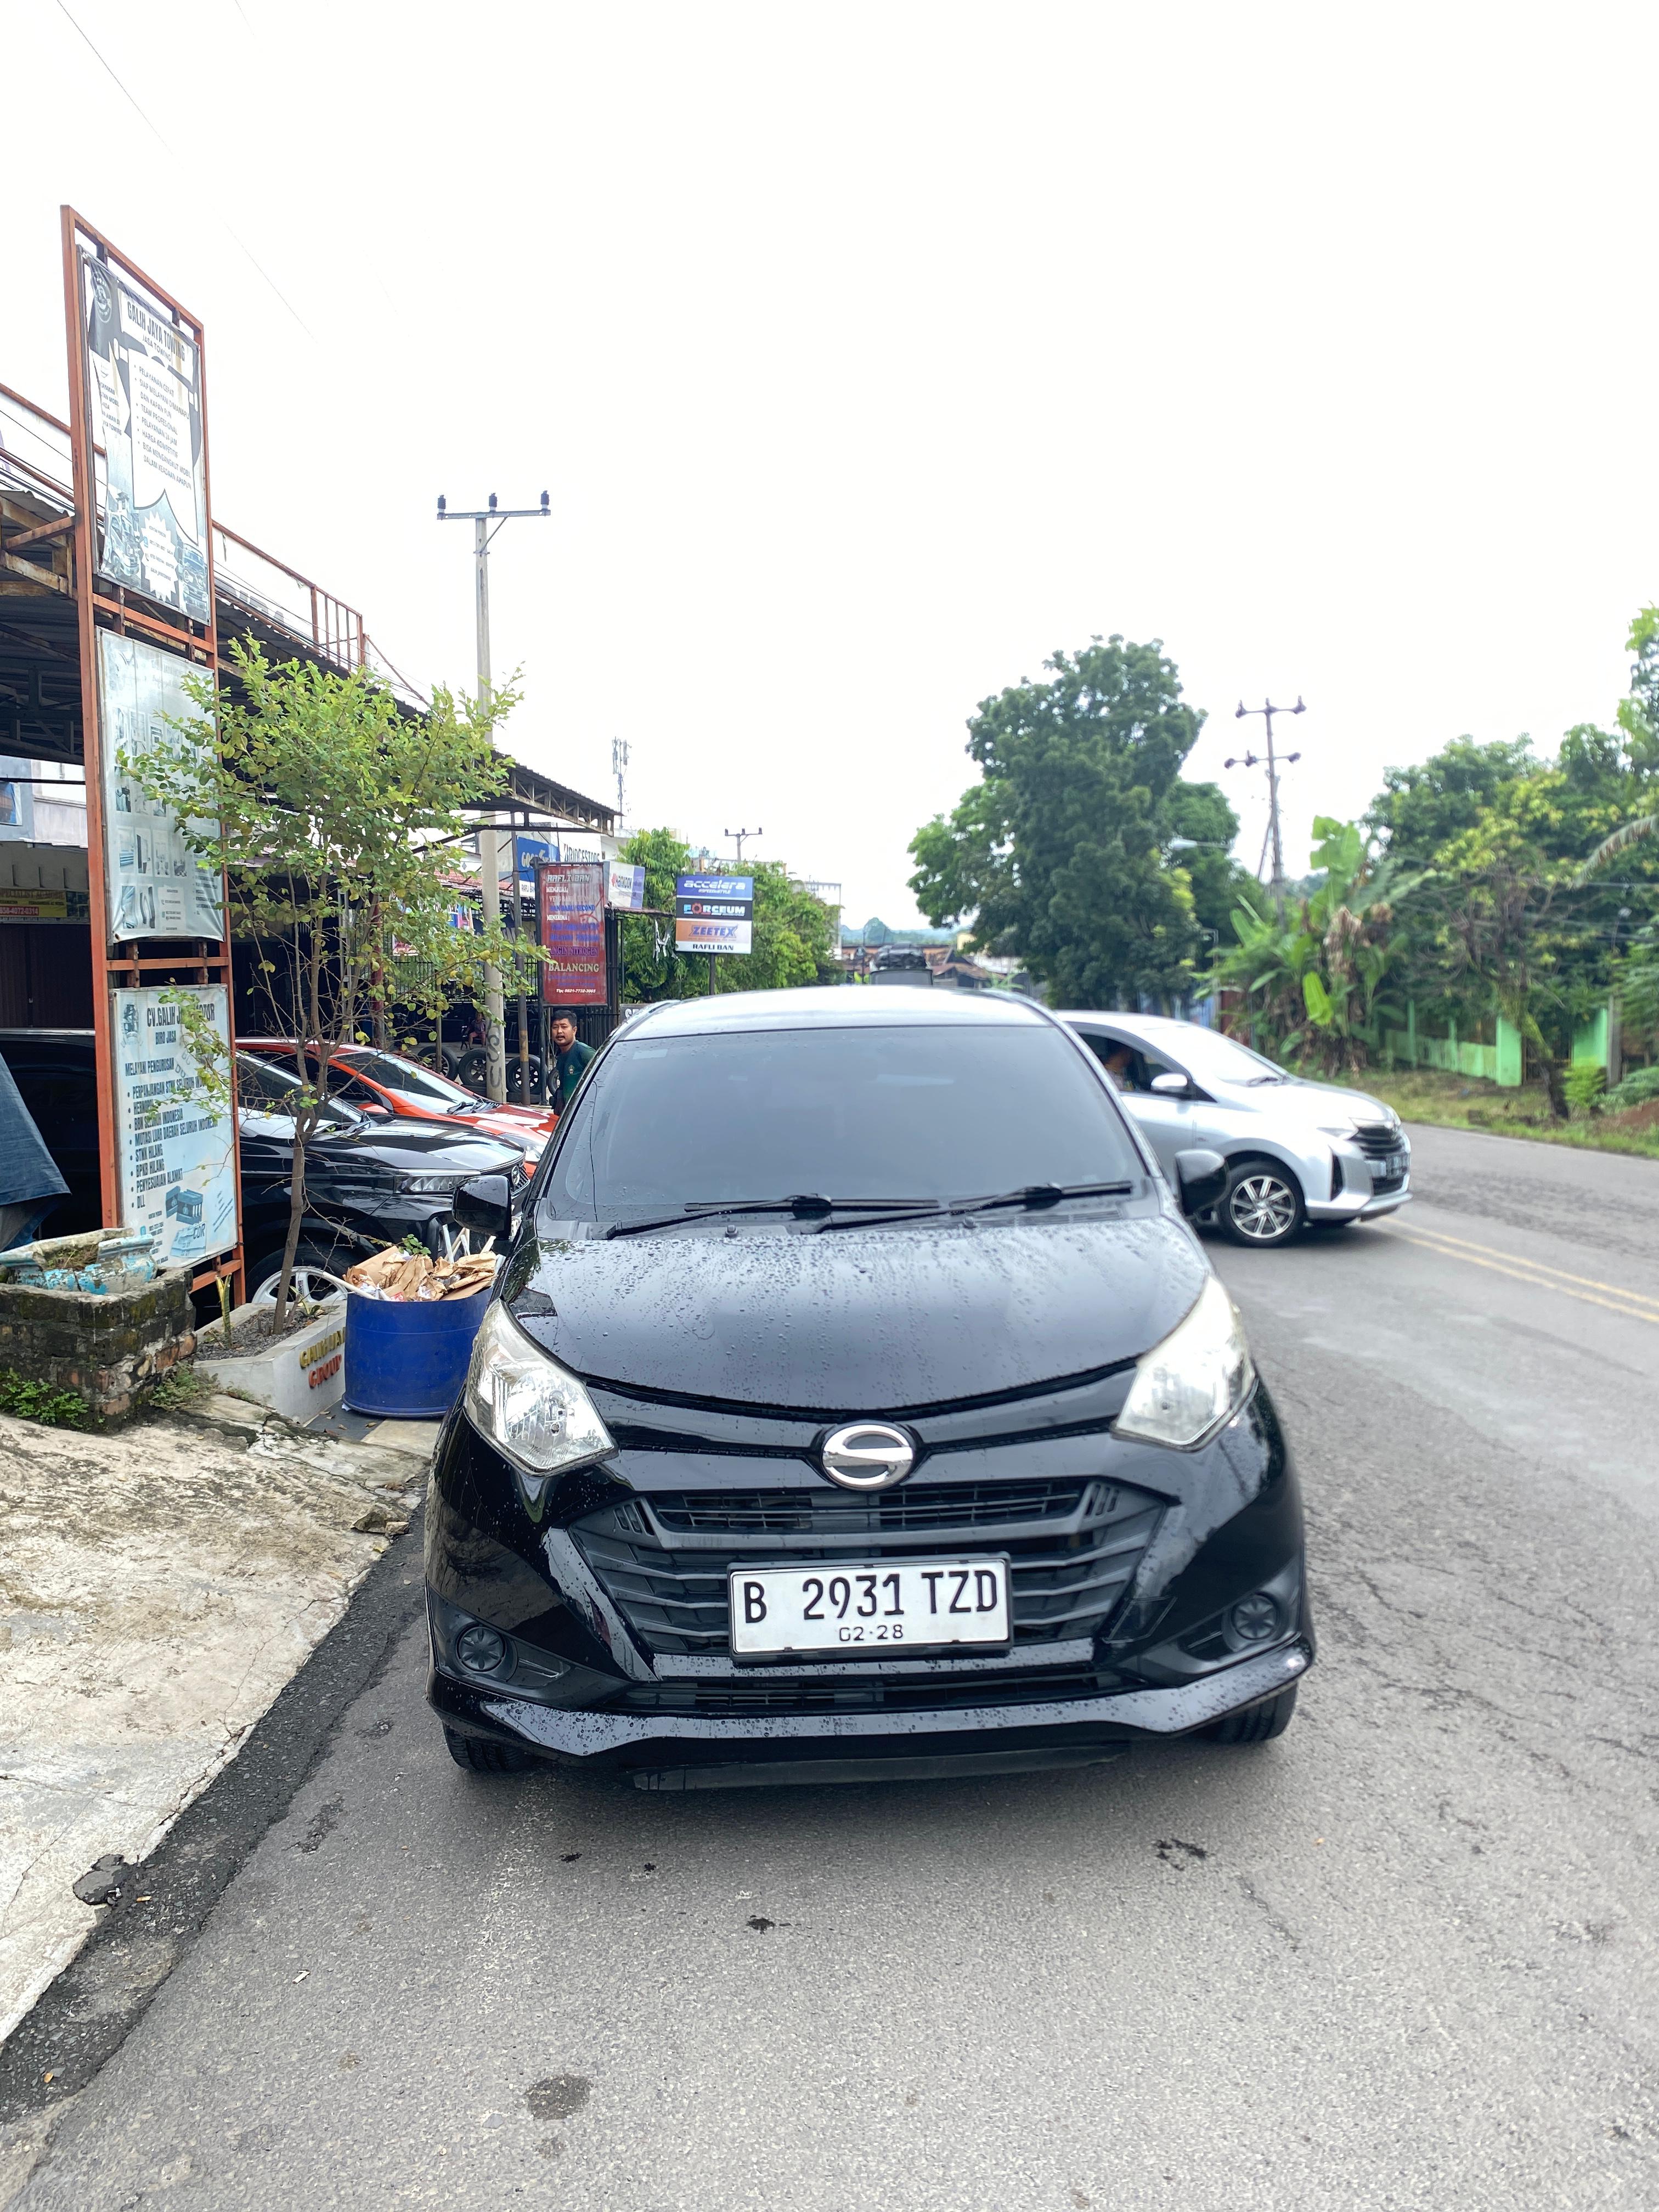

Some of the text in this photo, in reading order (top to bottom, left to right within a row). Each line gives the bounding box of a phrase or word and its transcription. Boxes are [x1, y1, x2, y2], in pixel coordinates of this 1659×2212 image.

[127, 301, 185, 361] GALIH JAYA TOWING
[143, 335, 171, 362] JASA TOWING
[139, 366, 174, 397] PELAYANAN CEPAT
[140, 379, 148, 390] SIAP
[149, 386, 168, 404] MELAYANI
[140, 392, 149, 403] DAN
[150, 399, 163, 413] KAPAN
[141, 404, 178, 435] TEAM PROFESIONAL
[142, 417, 165, 437] PELAYANAN
[143, 430, 156, 443] HARGA
[143, 442, 152, 454] BISA
[179, 466, 191, 478] MOBIL
[144, 455, 157, 469] DALAM
[176, 476, 191, 490] APAPUN
[564, 844, 600, 862] BRIDGESTONE
[546, 874, 590, 883] RAFLI BAN
[684, 879, 746, 890] accelera
[684, 901, 745, 916] FORCEUM
[692, 925, 738, 938] ZEETEX
[569, 946, 598, 955] NITROGEN
[549, 963, 599, 972] BALANCING
[195, 1003, 215, 1022] OTOR
[156, 1031, 165, 1045] BIRO
[166, 1030, 176, 1043] JASA
[125, 1061, 147, 1076] MELAYANI
[147, 1057, 174, 1073] PENGURUSAN
[133, 1081, 165, 1099] PERPANJANGAN
[162, 1108, 184, 1125] INDONESIA
[135, 1131, 152, 1147] MUTASI
[152, 1128, 163, 1142] LUAR
[163, 1124, 179, 1139] DAERAH
[179, 1120, 198, 1136] SELURUH
[136, 1143, 163, 1162] STNK HILANG
[136, 1158, 165, 1177] BPKB HILANG
[137, 1168, 183, 1193] PENYESUAIAN ALAMAT
[137, 1195, 145, 1209] DLL
[744, 1570, 998, 1623] B 2931 TZD
